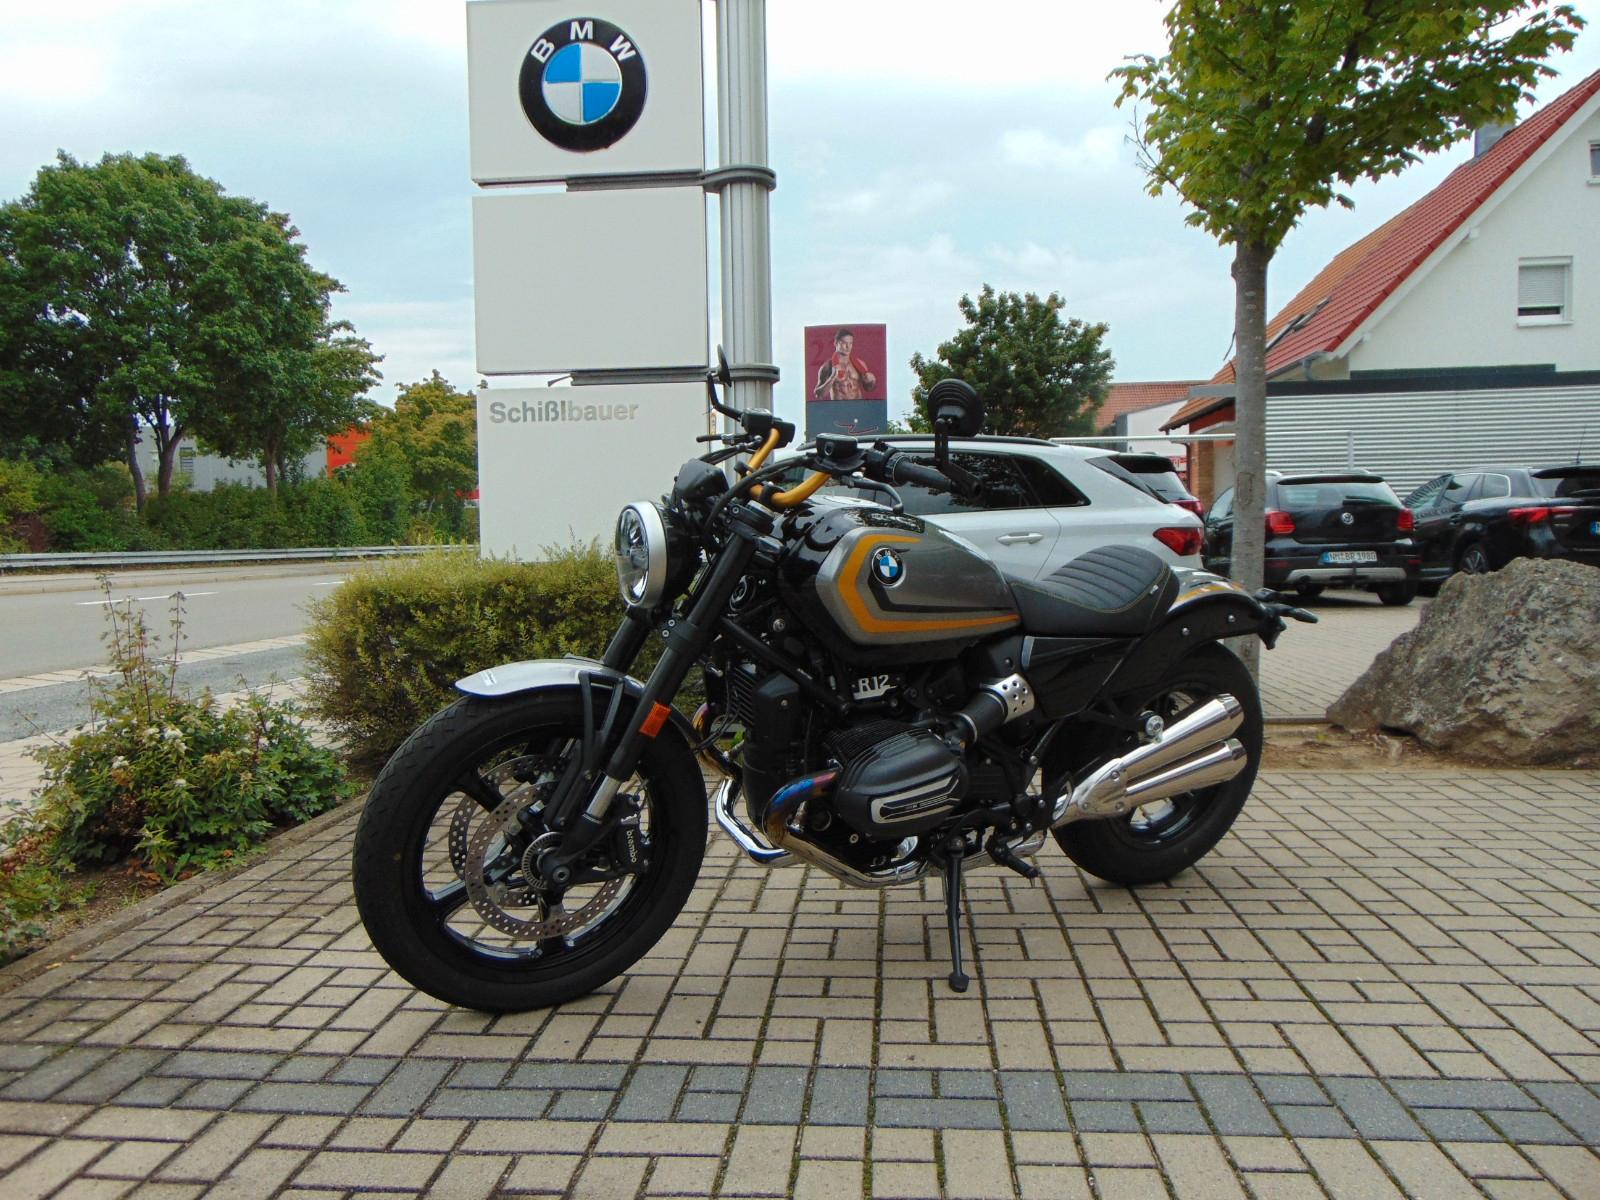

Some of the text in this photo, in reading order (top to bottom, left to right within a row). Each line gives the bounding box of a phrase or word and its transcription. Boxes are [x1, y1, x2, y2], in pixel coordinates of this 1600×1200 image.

[530, 20, 637, 64] BMW
[489, 400, 639, 424] Schißlbauer
[626, 829, 638, 863] brembo
